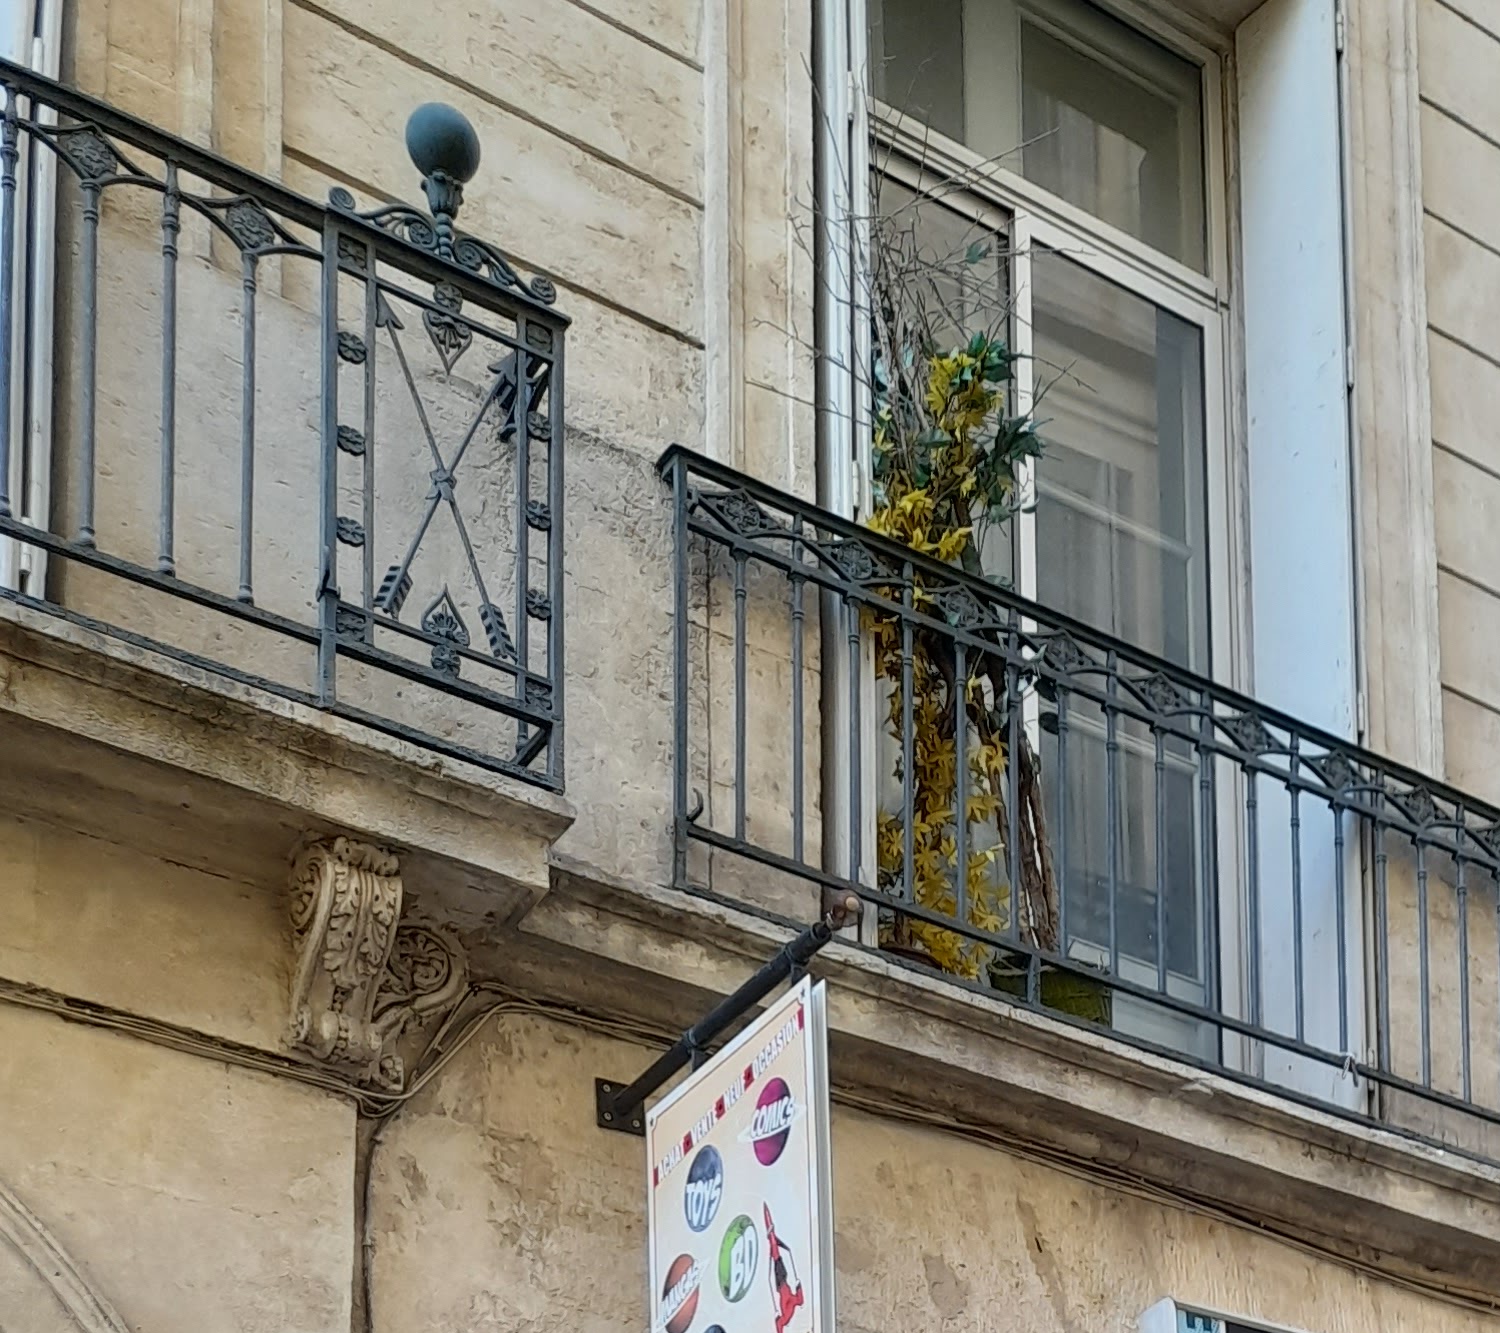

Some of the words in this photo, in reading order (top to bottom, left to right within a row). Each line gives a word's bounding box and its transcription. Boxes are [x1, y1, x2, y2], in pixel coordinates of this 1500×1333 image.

[751, 1014, 799, 1079] OCCASION
[750, 1096, 796, 1139] COMICS
[686, 1174, 721, 1227] TOYS
[656, 1259, 701, 1328] MANGAS
[730, 1225, 757, 1300] BD
